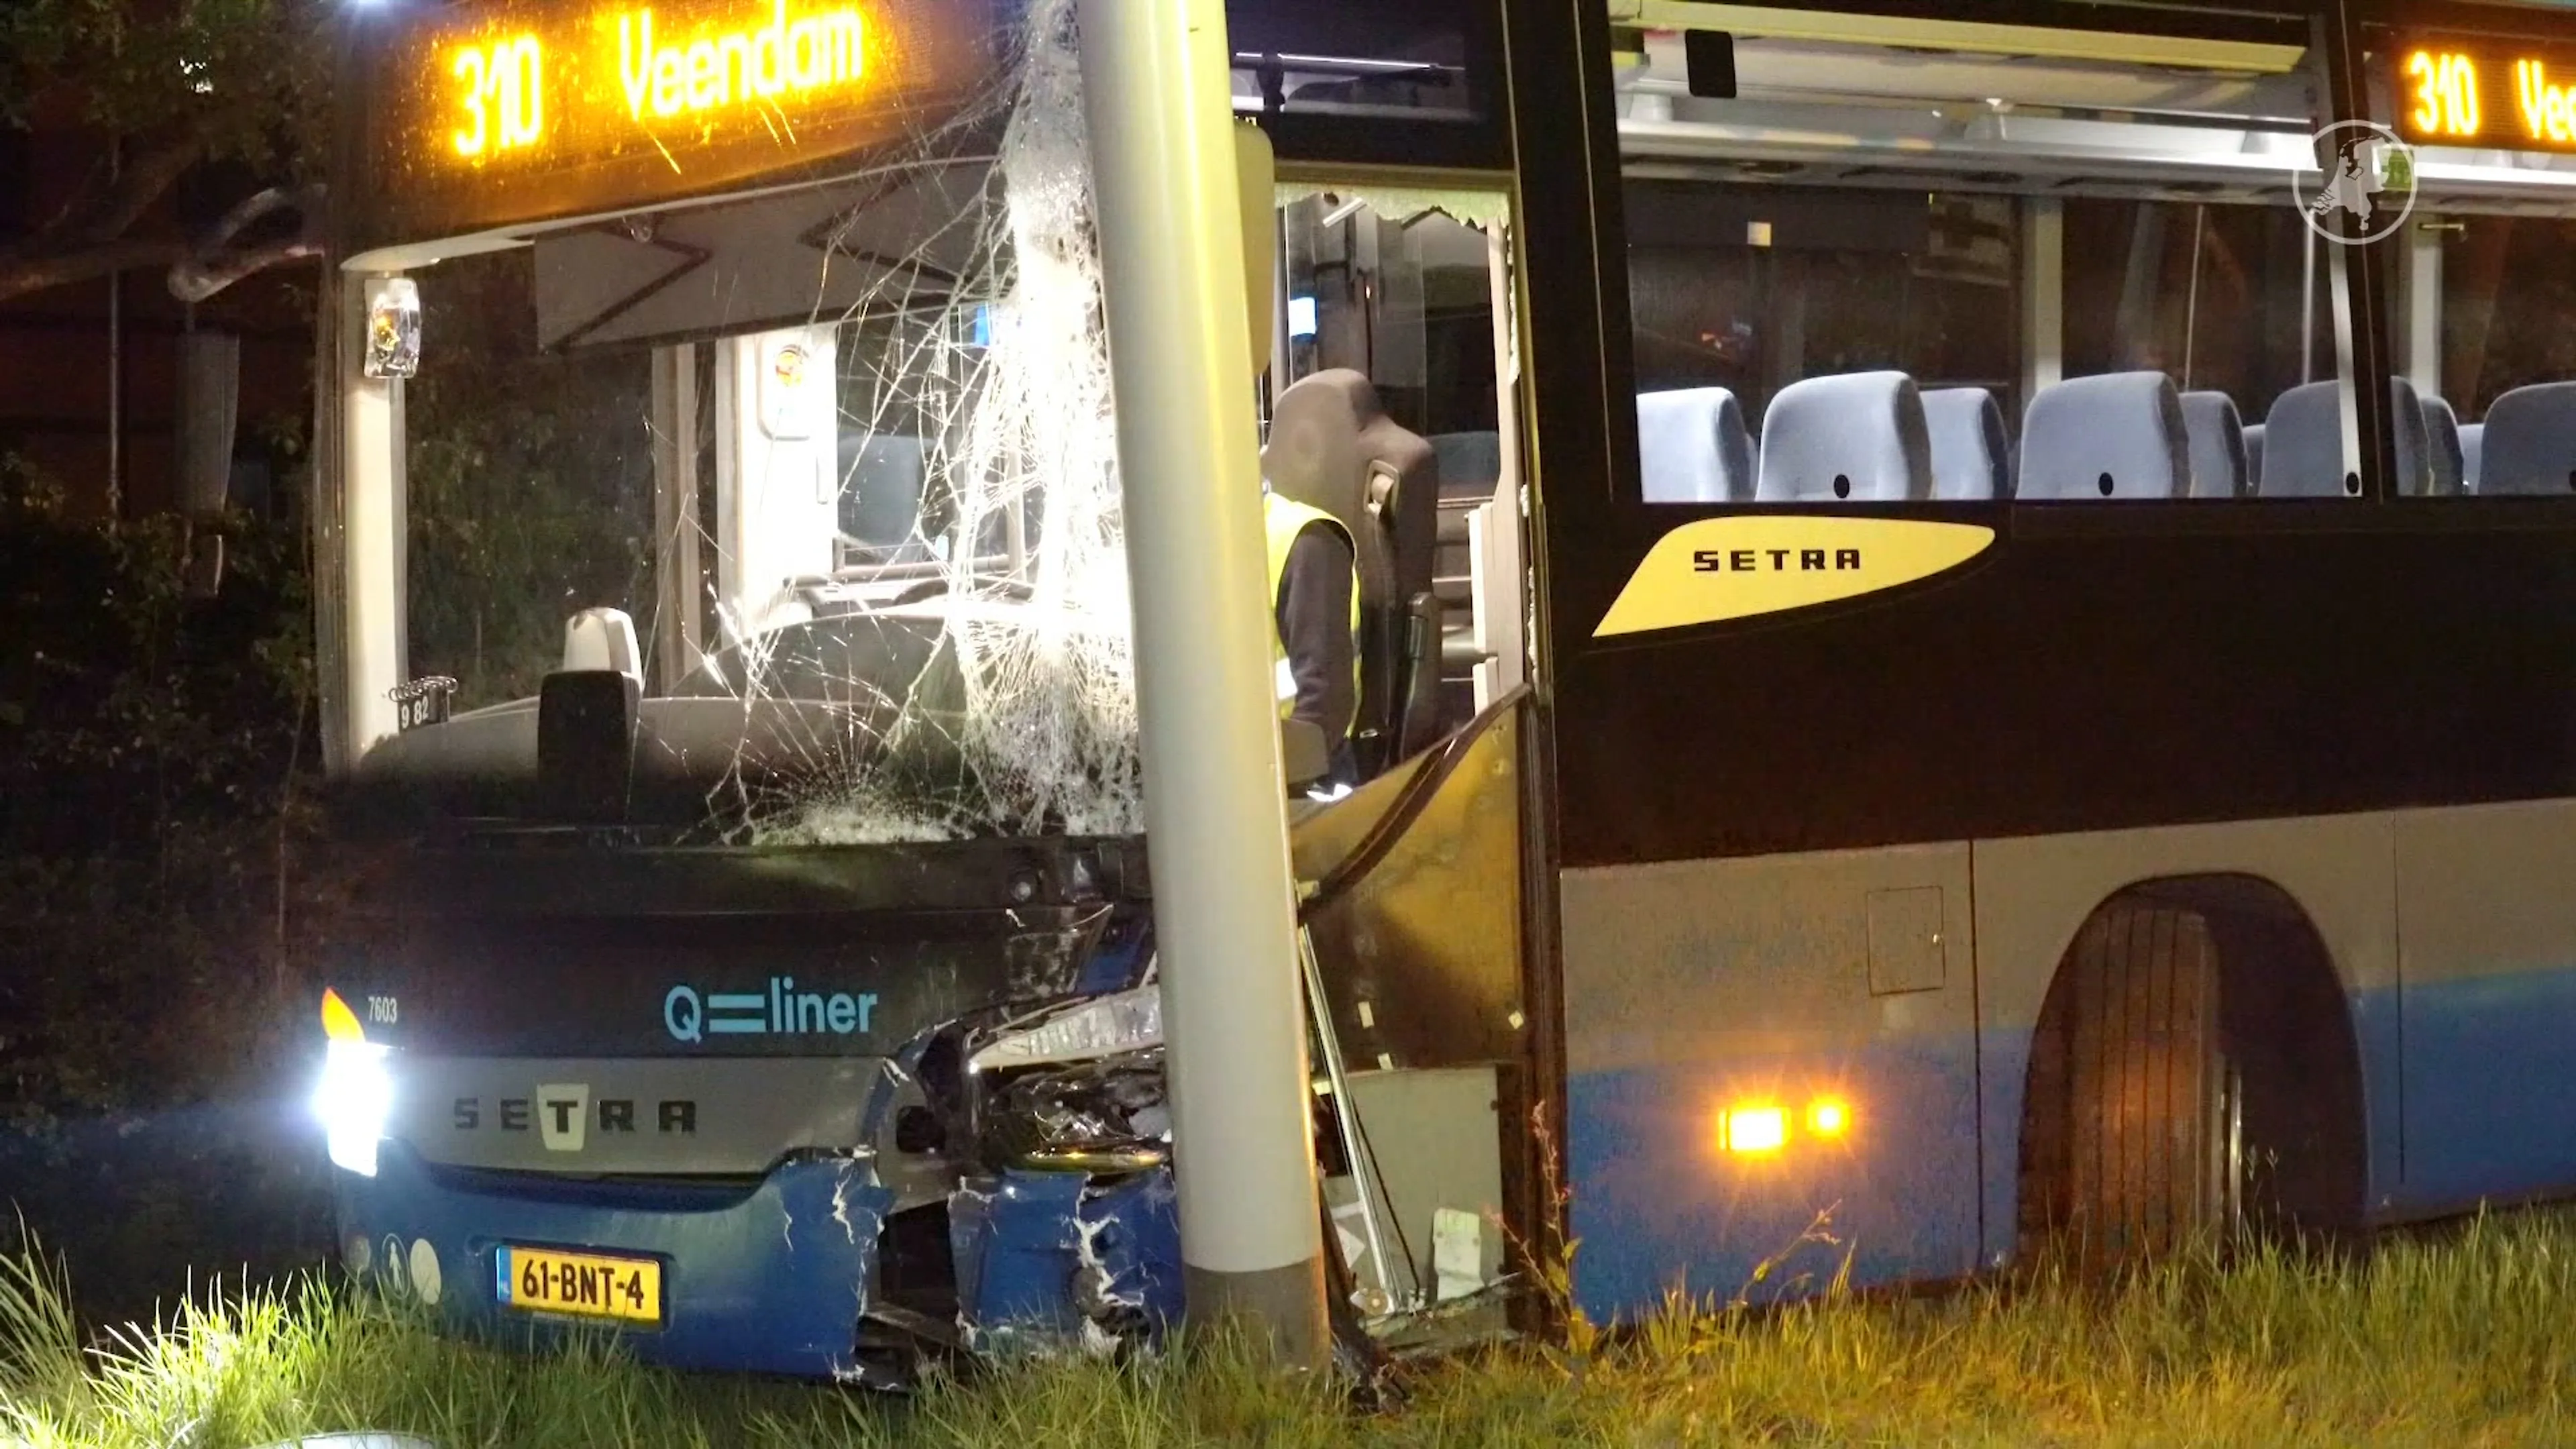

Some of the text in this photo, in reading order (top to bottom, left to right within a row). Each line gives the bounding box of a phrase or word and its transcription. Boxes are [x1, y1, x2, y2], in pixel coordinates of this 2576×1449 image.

[452, 0, 864, 156] 310 Veendam
[2410, 51, 2480, 136] 310
[1694, 549, 1860, 572] SETRA
[368, 996, 398, 1024] 7603
[453, 1097, 697, 1134] SETRA
[522, 1258, 644, 1309] 61-BNT-4
